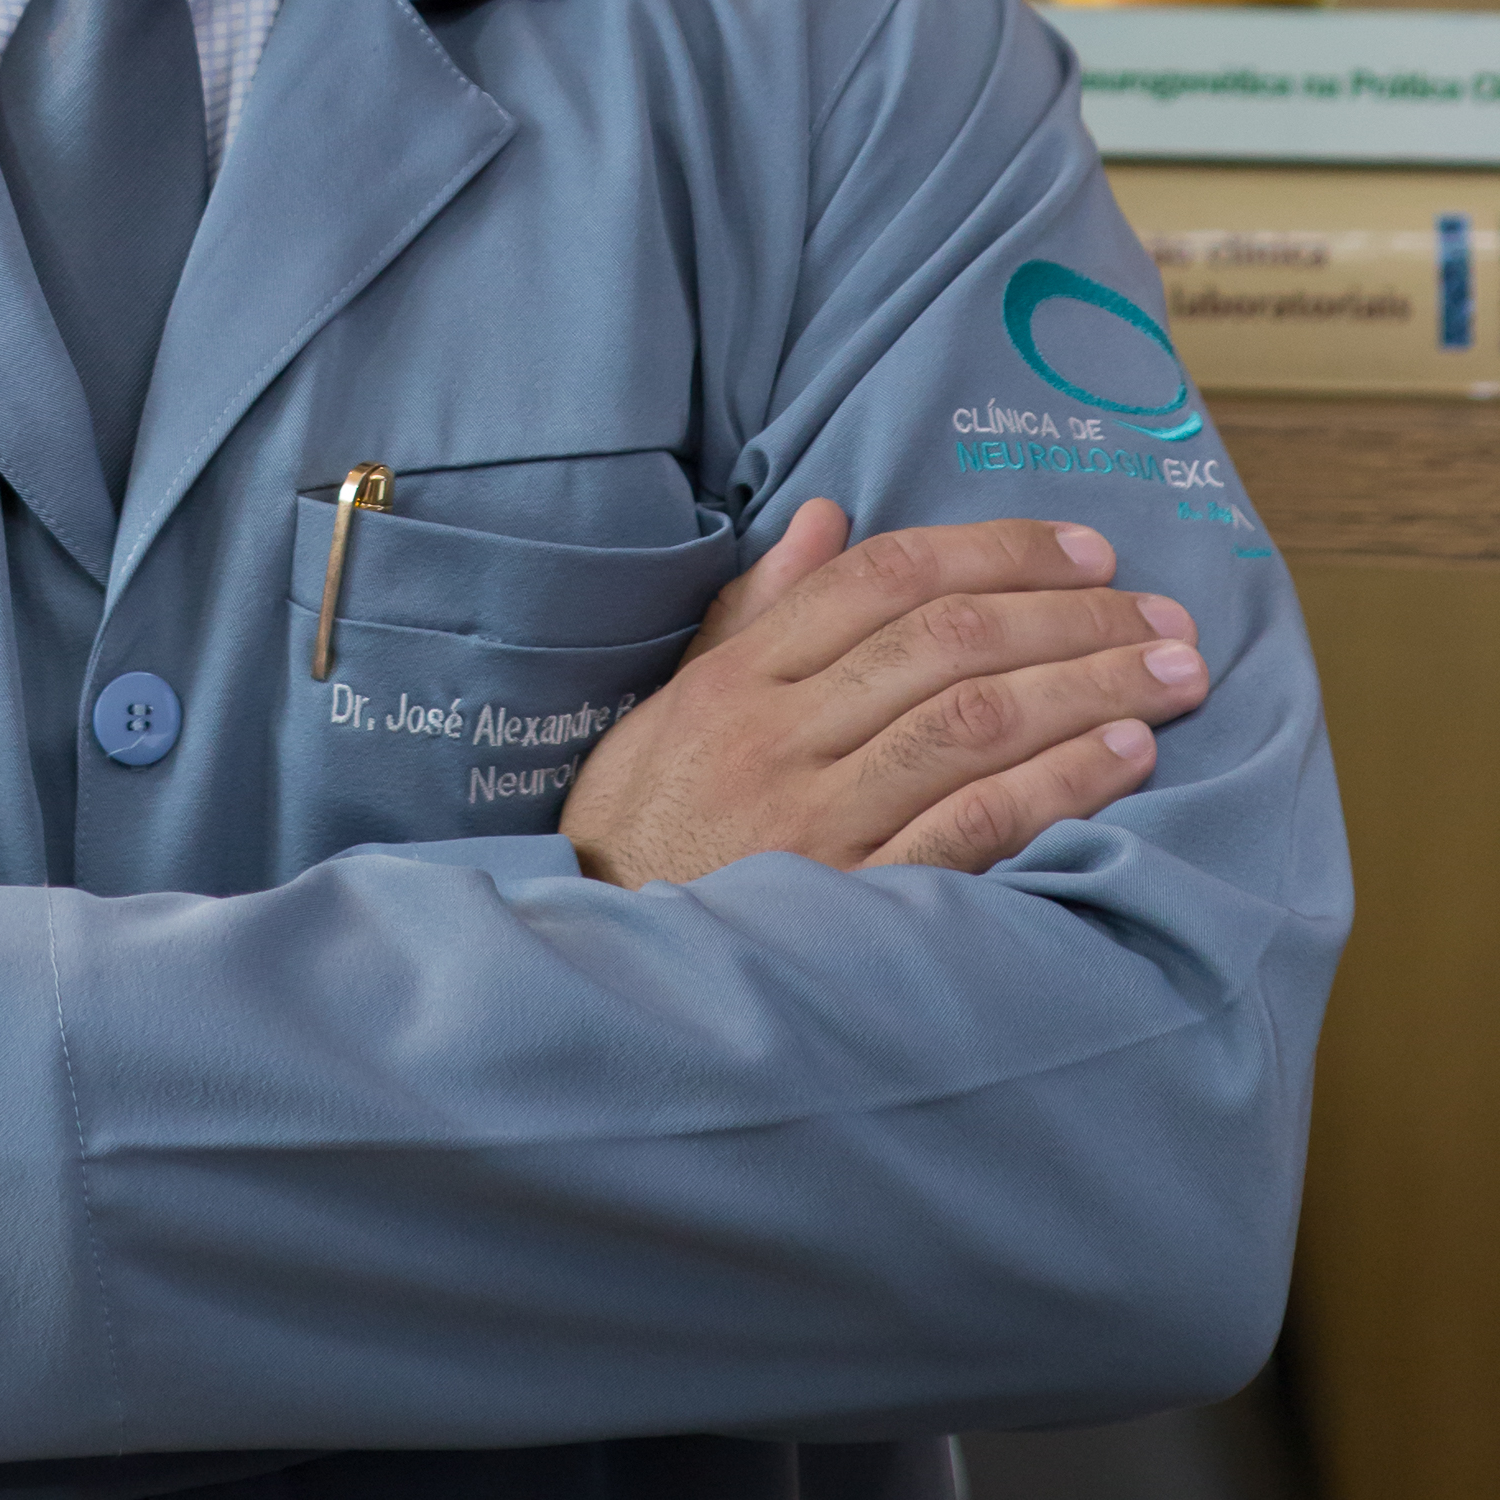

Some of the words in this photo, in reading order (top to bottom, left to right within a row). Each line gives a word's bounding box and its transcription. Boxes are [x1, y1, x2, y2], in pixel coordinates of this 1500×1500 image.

[953, 398, 1061, 440] CLÍNICA
[1069, 416, 1106, 441] DE
[331, 683, 374, 731] Dr.
[386, 694, 464, 739] José
[472, 701, 611, 747] Alexandre
